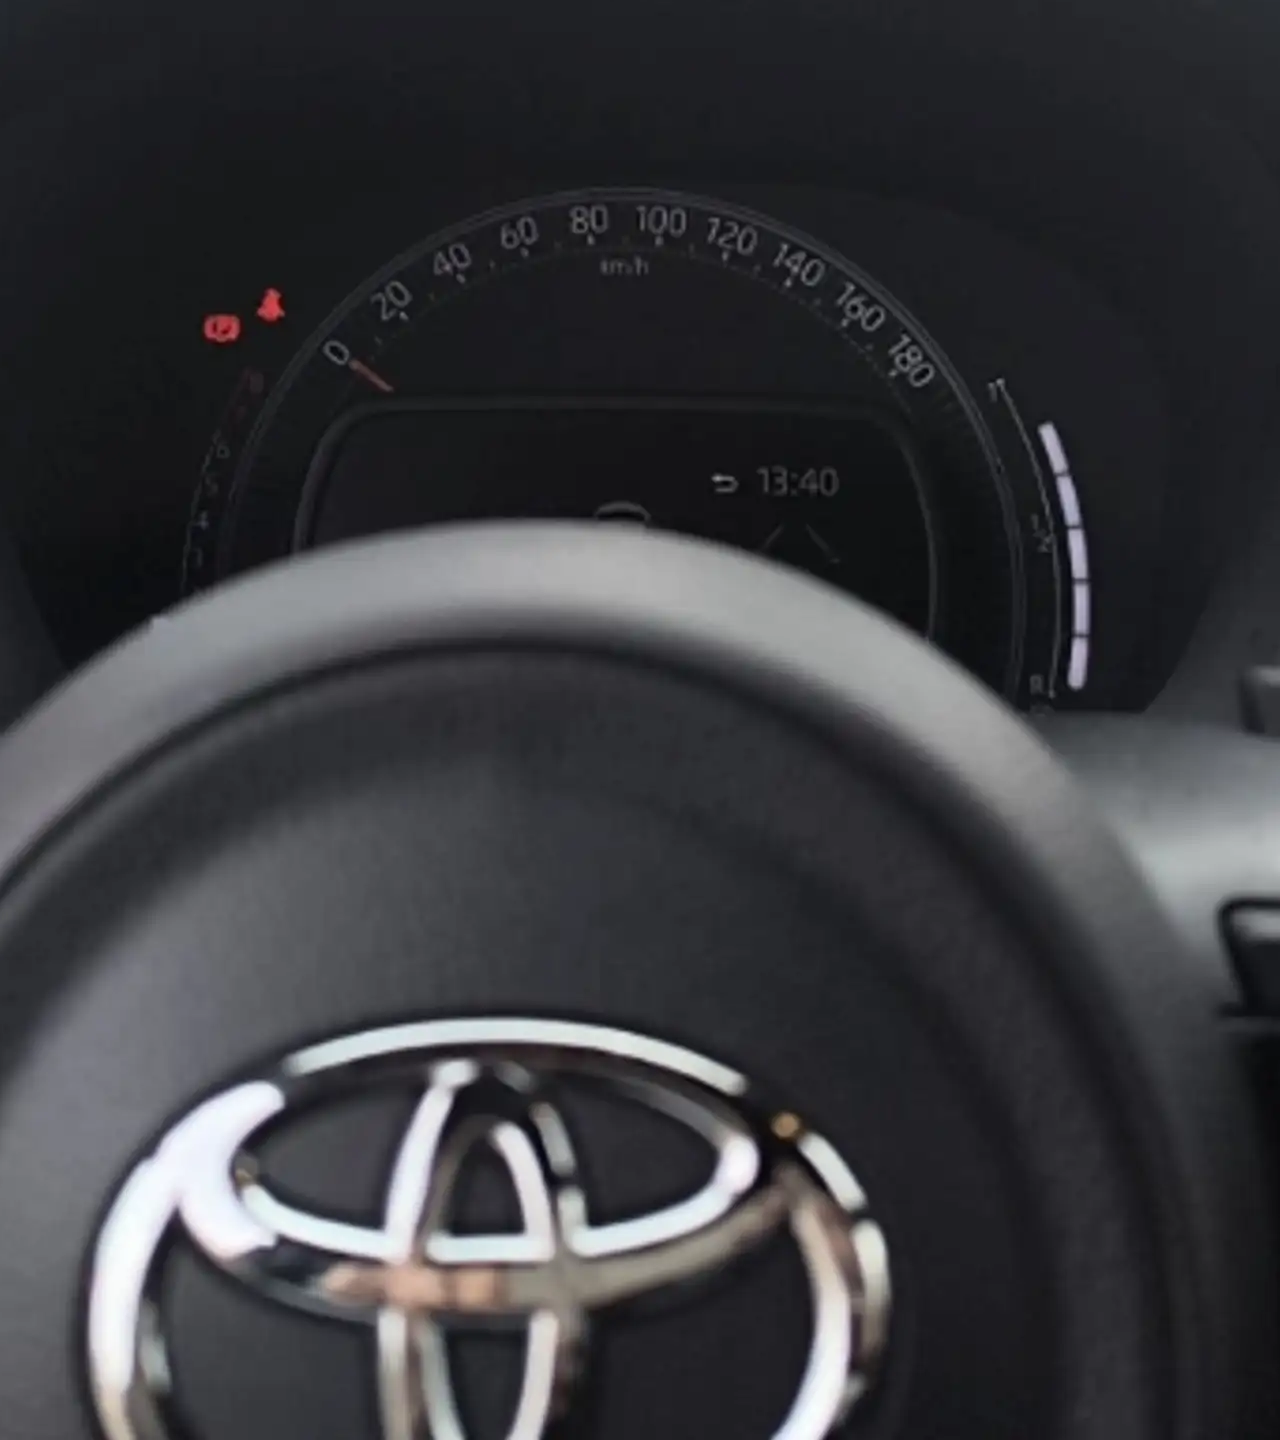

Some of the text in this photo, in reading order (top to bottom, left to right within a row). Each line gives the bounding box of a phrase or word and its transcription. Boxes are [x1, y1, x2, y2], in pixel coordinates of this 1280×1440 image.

[370, 280, 413, 322] 20
[433, 242, 472, 276] 40
[500, 215, 539, 250] 60
[569, 203, 610, 234] 80
[635, 204, 688, 238] 100
[706, 216, 758, 256] 120
[773, 242, 826, 287] 140
[835, 280, 886, 332] 160
[888, 333, 935, 388] 180
[755, 464, 840, 498] 13:40
